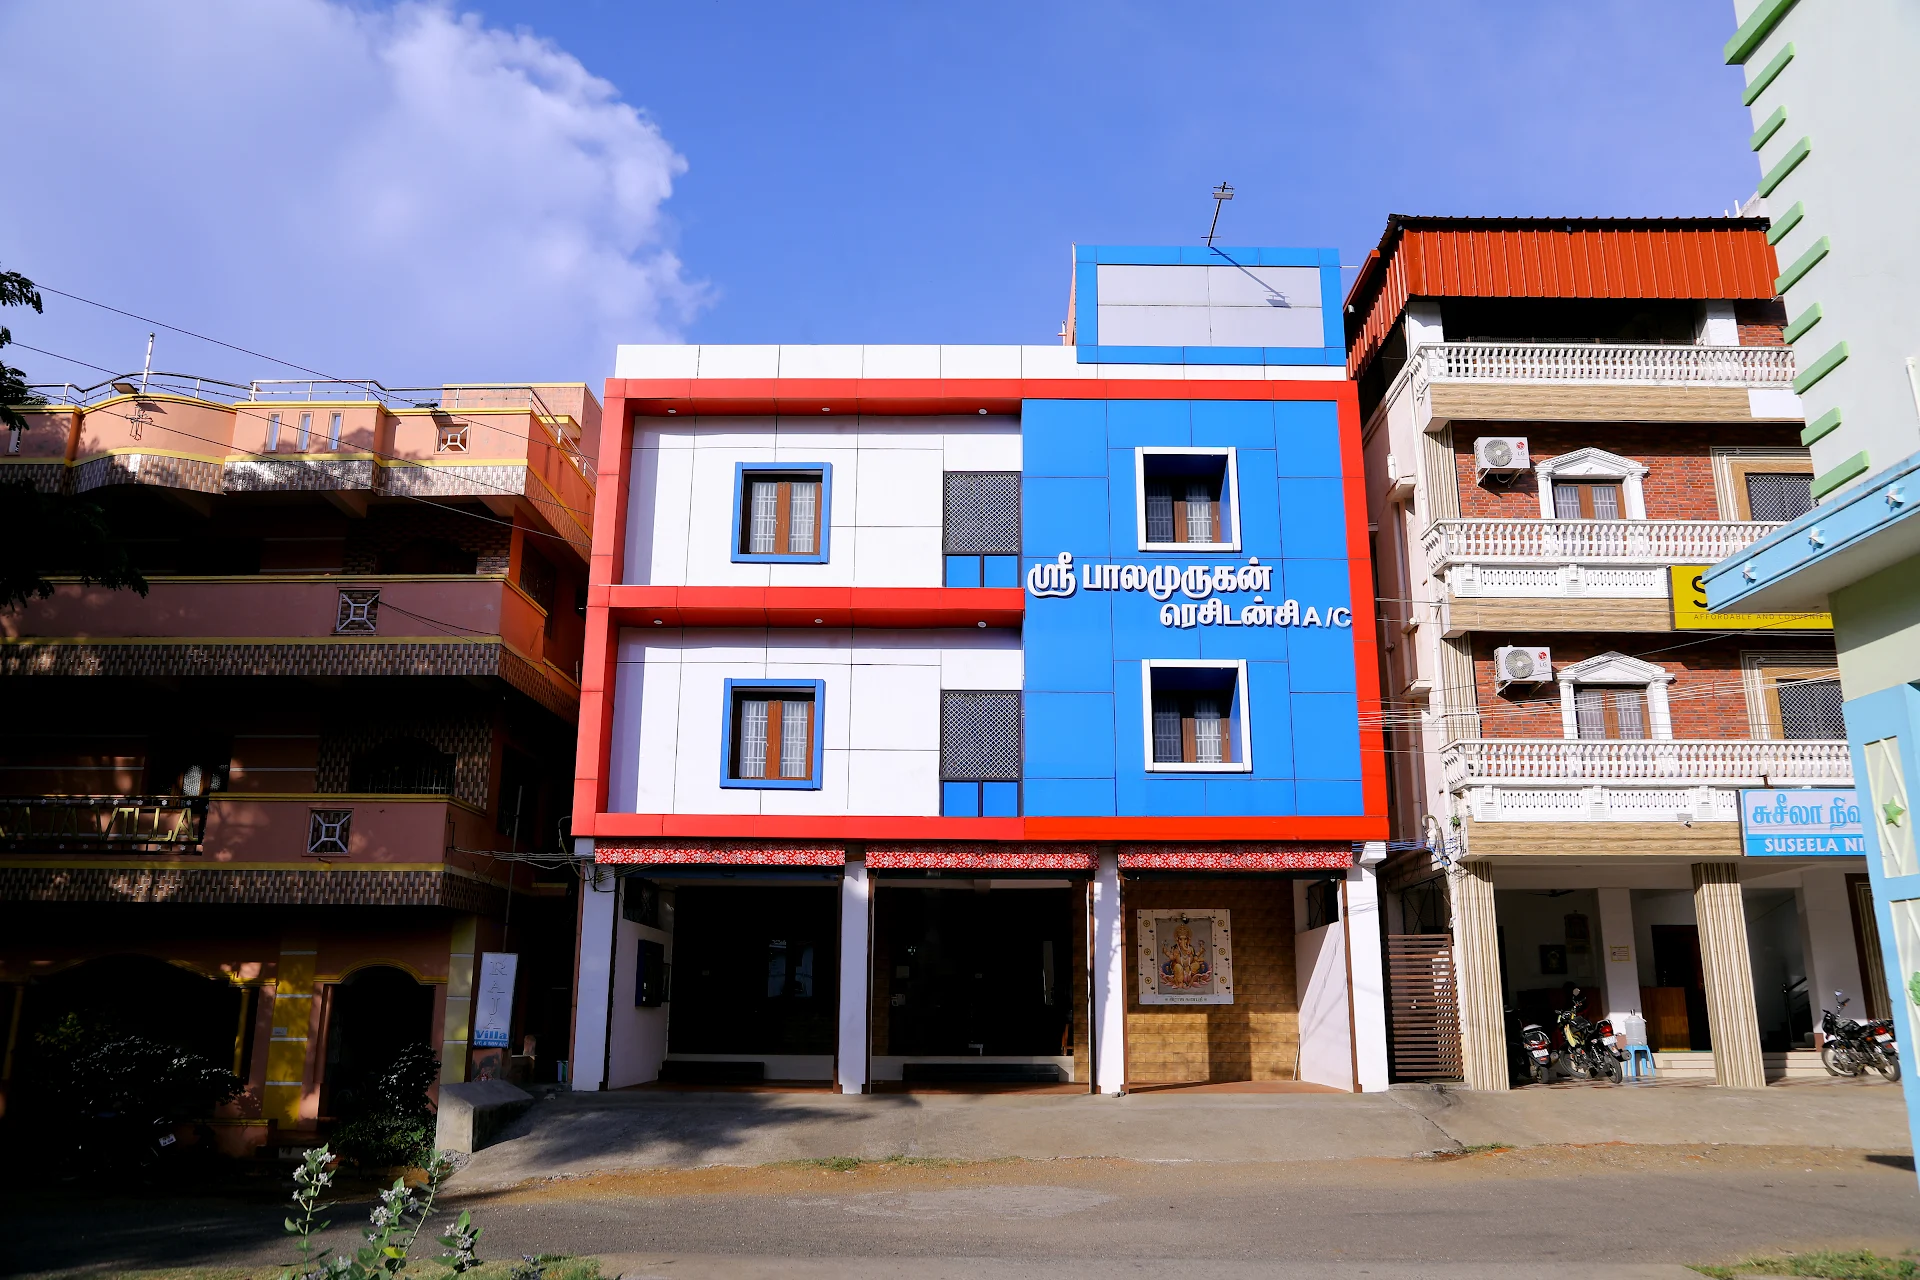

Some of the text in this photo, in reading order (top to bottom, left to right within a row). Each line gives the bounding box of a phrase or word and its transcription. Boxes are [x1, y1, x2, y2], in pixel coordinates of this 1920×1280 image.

[1082, 556, 1273, 600] பாலமுருகன்
[1160, 595, 1352, 629] ரெசிடன்சி A/C
[91, 806, 199, 842] VILLA
[1752, 793, 1823, 825] சுசீலா
[1764, 837, 1839, 853] SUSEELA
[476, 1030, 508, 1039] Villa
